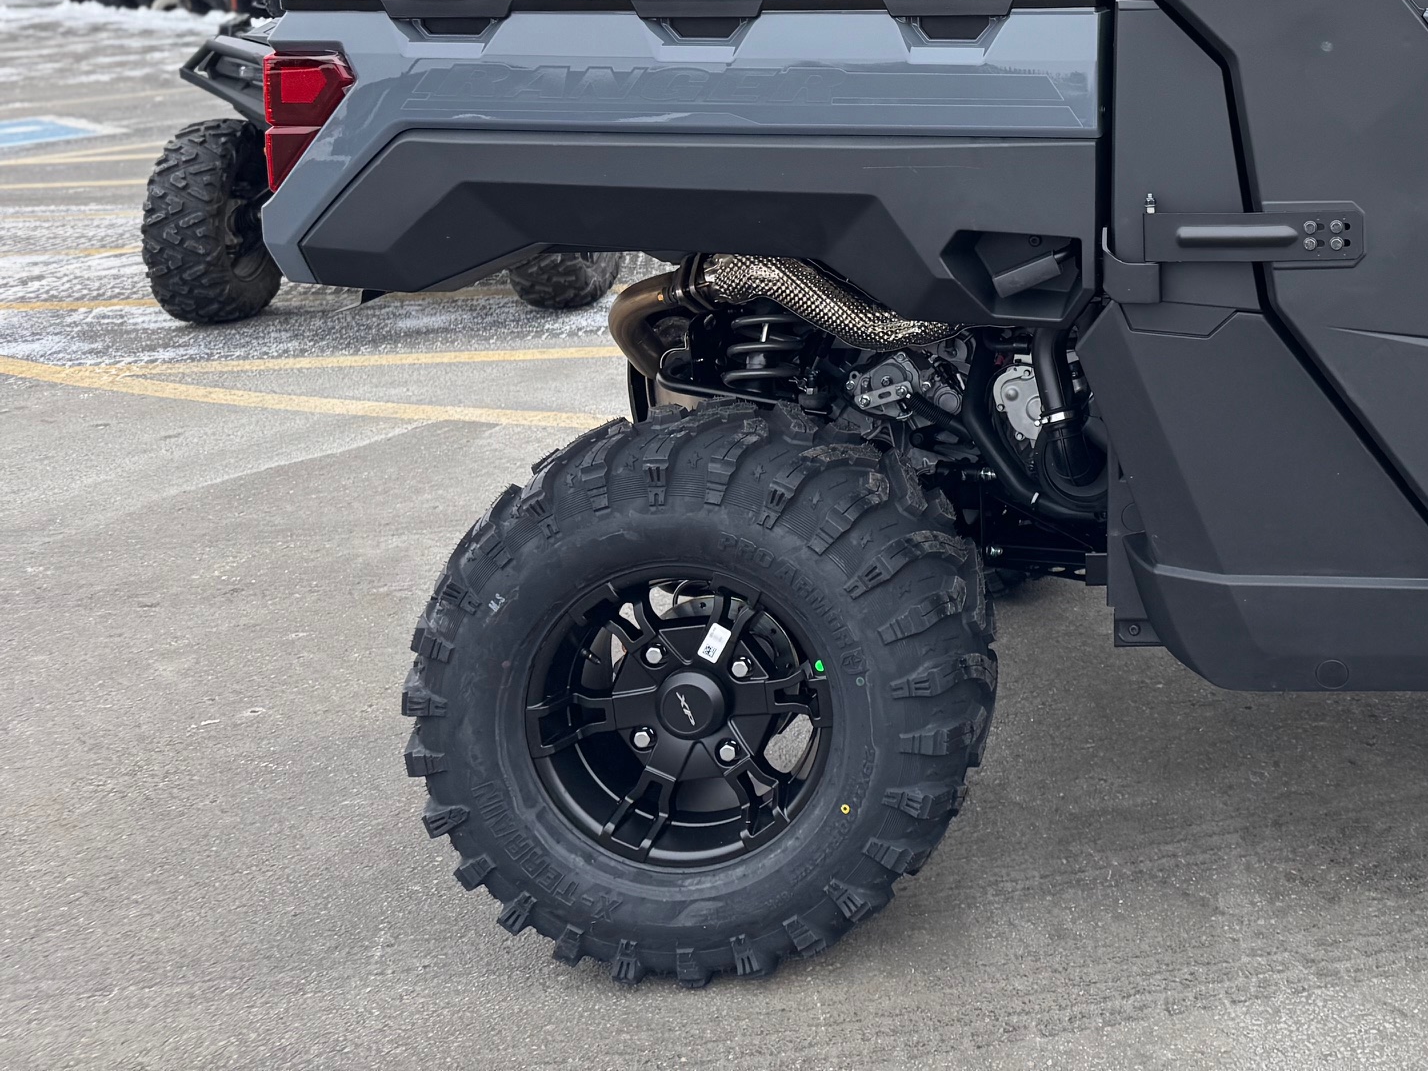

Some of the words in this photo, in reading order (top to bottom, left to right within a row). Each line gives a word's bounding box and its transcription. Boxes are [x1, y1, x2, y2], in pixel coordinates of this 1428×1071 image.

[434, 62, 848, 104] RANGER
[718, 531, 775, 568] PRO
[773, 557, 855, 649] ARMOR
[675, 691, 696, 727] XP
[471, 780, 624, 923] X-TERRAIN
